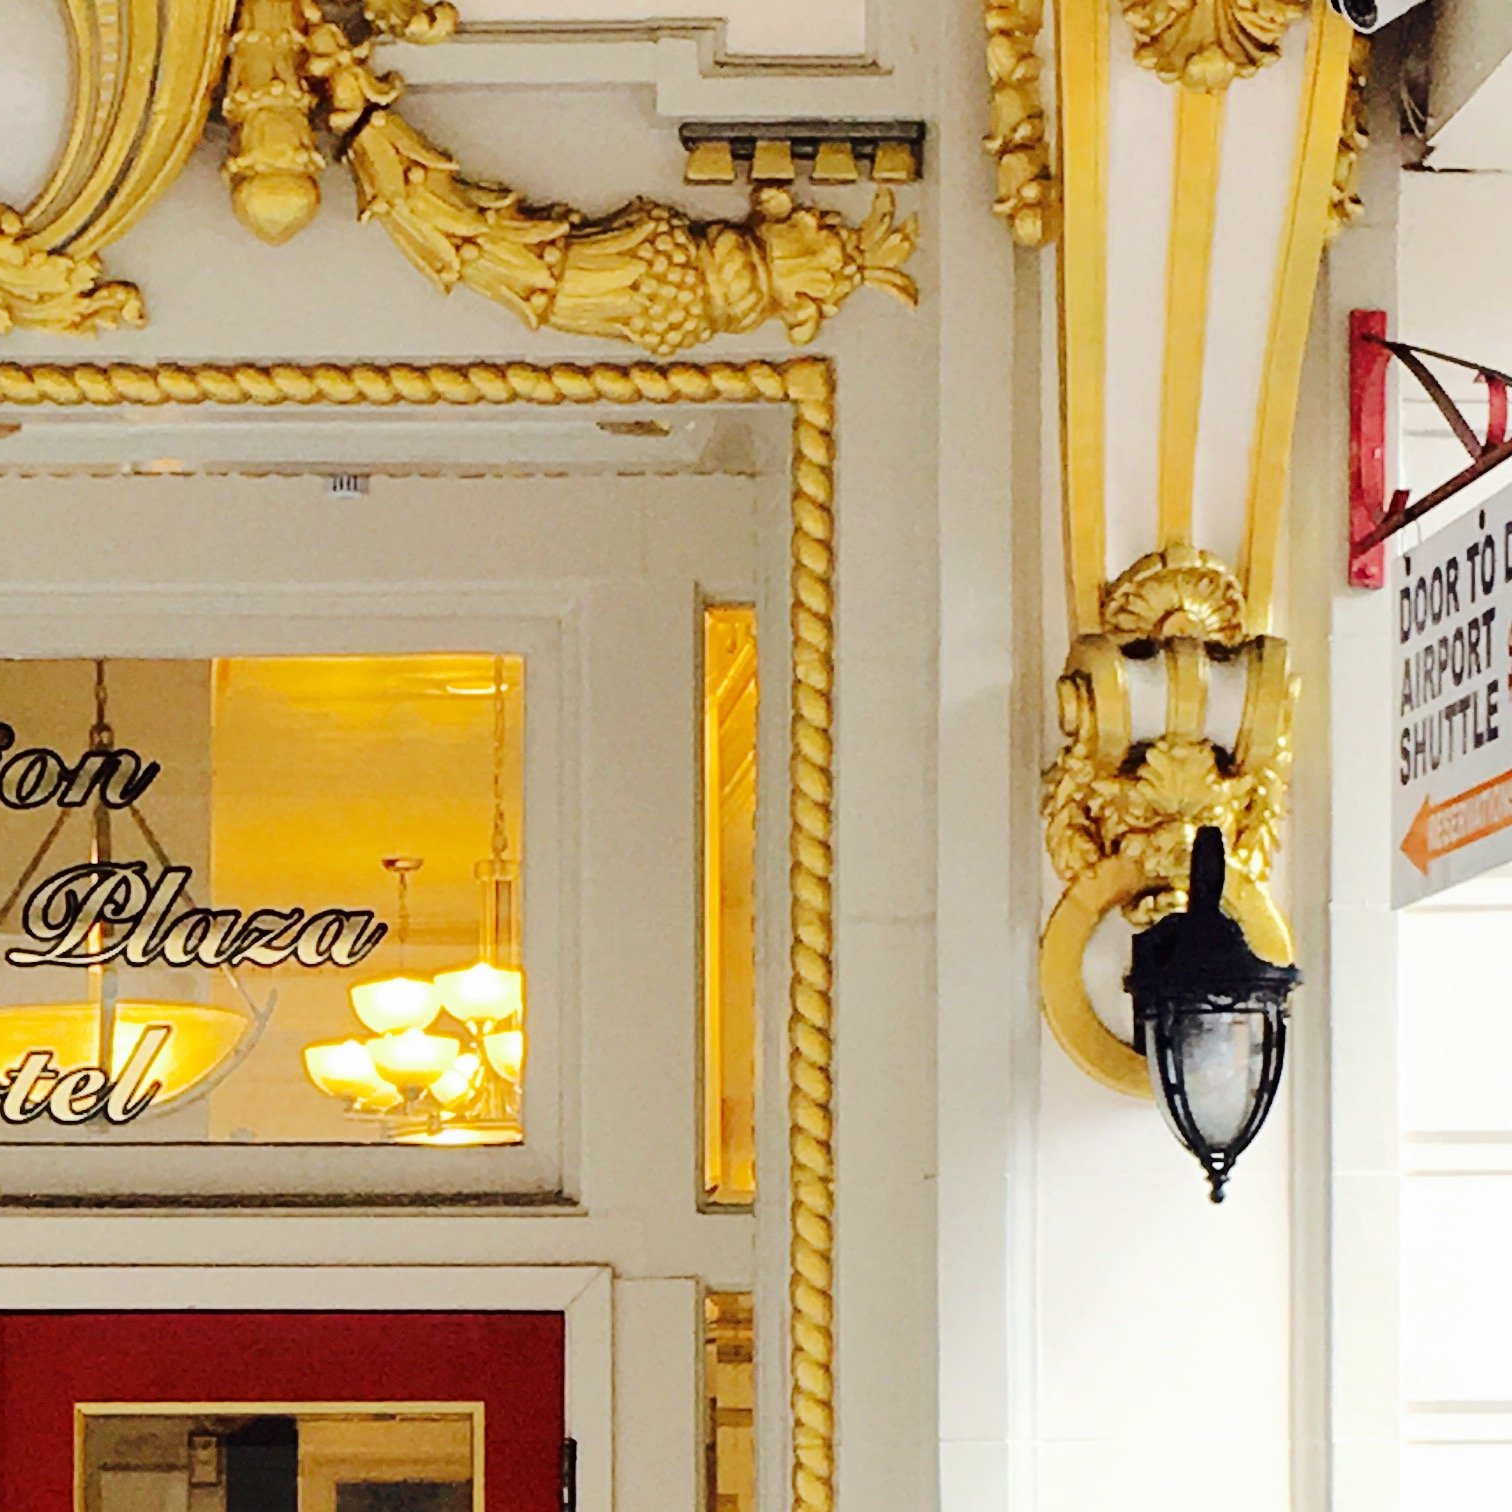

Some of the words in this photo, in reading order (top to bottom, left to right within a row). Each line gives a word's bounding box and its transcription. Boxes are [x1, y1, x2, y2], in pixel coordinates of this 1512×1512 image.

[1400, 556, 1460, 644] DOOR
[1467, 534, 1495, 603] TO
[1400, 607, 1496, 717] AIRPORT
[1400, 679, 1499, 785] SHUTTLE
[5, 861, 388, 968] Plaza
